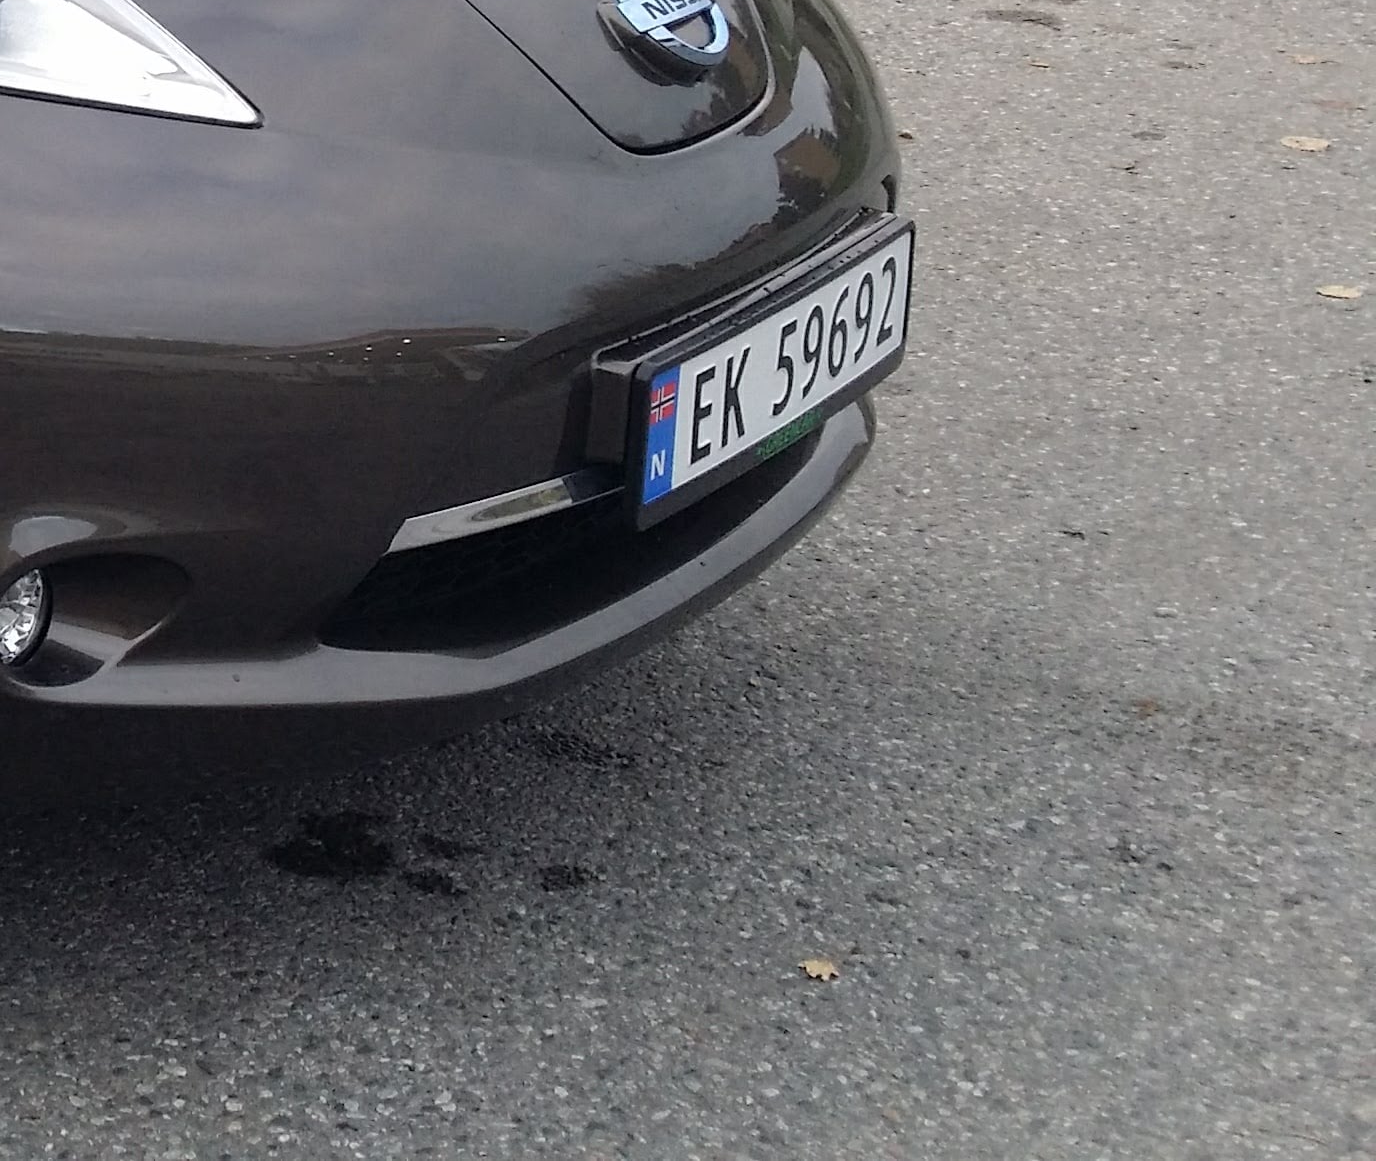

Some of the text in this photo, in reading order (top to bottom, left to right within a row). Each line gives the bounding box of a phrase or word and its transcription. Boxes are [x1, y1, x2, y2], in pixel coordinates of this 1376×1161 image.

[689, 255, 897, 466] EK 59692
[650, 448, 666, 481] N
